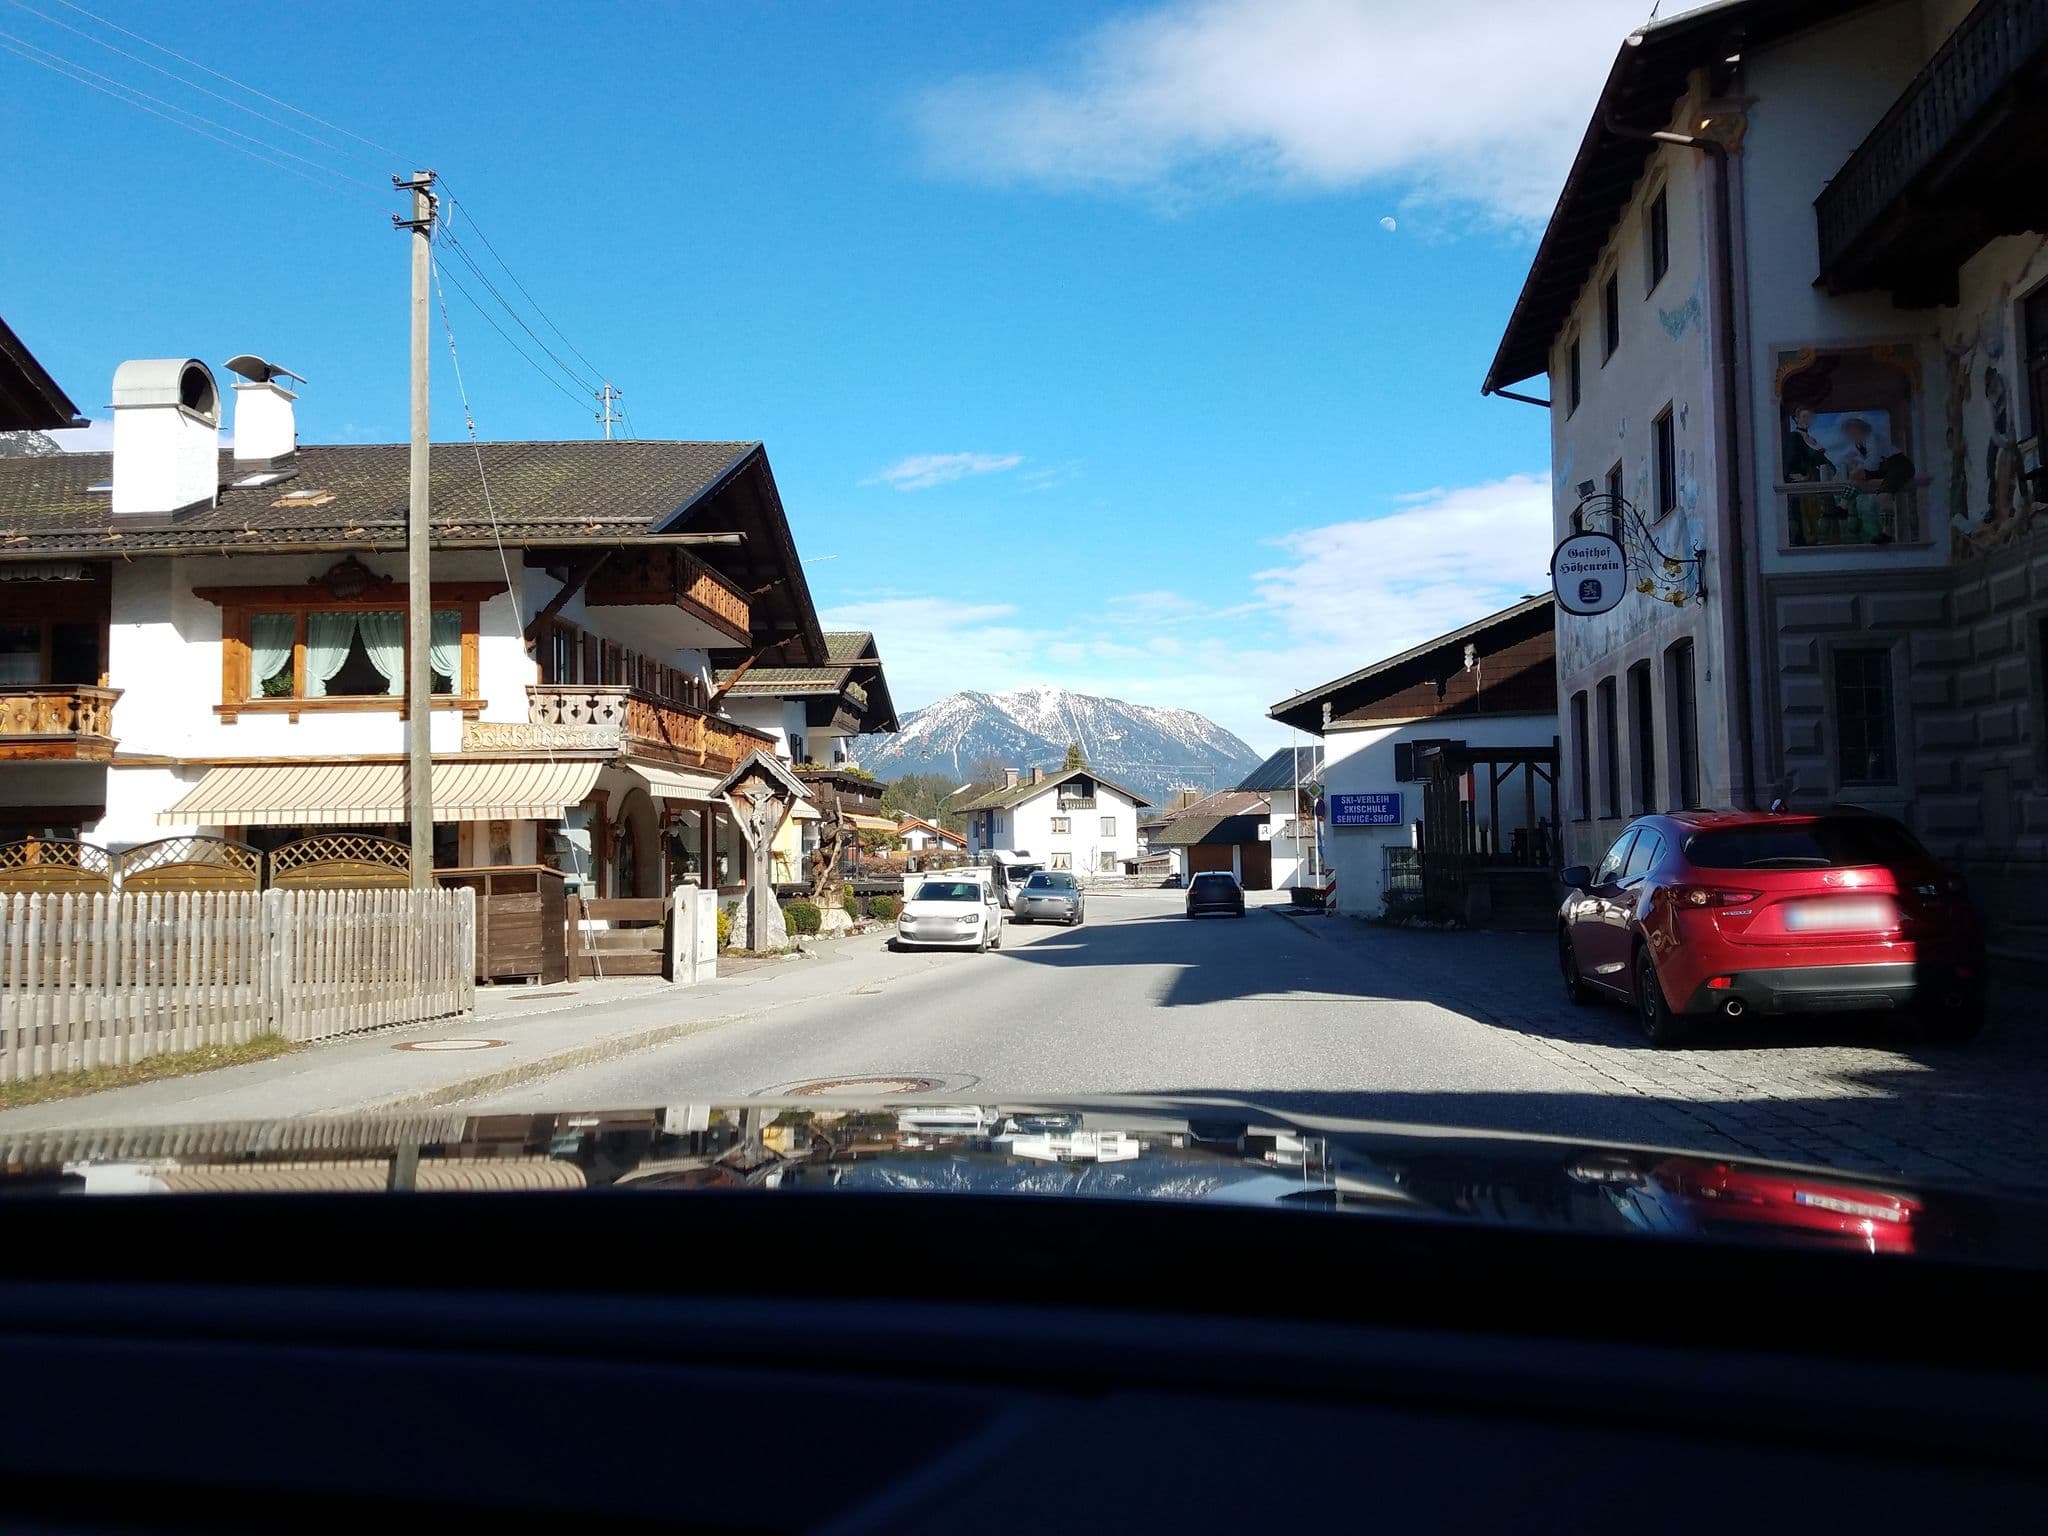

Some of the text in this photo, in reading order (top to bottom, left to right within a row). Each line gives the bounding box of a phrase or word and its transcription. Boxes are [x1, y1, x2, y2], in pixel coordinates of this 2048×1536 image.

[1567, 546, 1611, 559] Gasthof
[1559, 560, 1619, 574] Höhenrain
[1341, 795, 1390, 804] SKI-VERLEIH
[1343, 805, 1387, 814] SKISCHULE
[1336, 814, 1395, 823] SERVICE-SHOP
